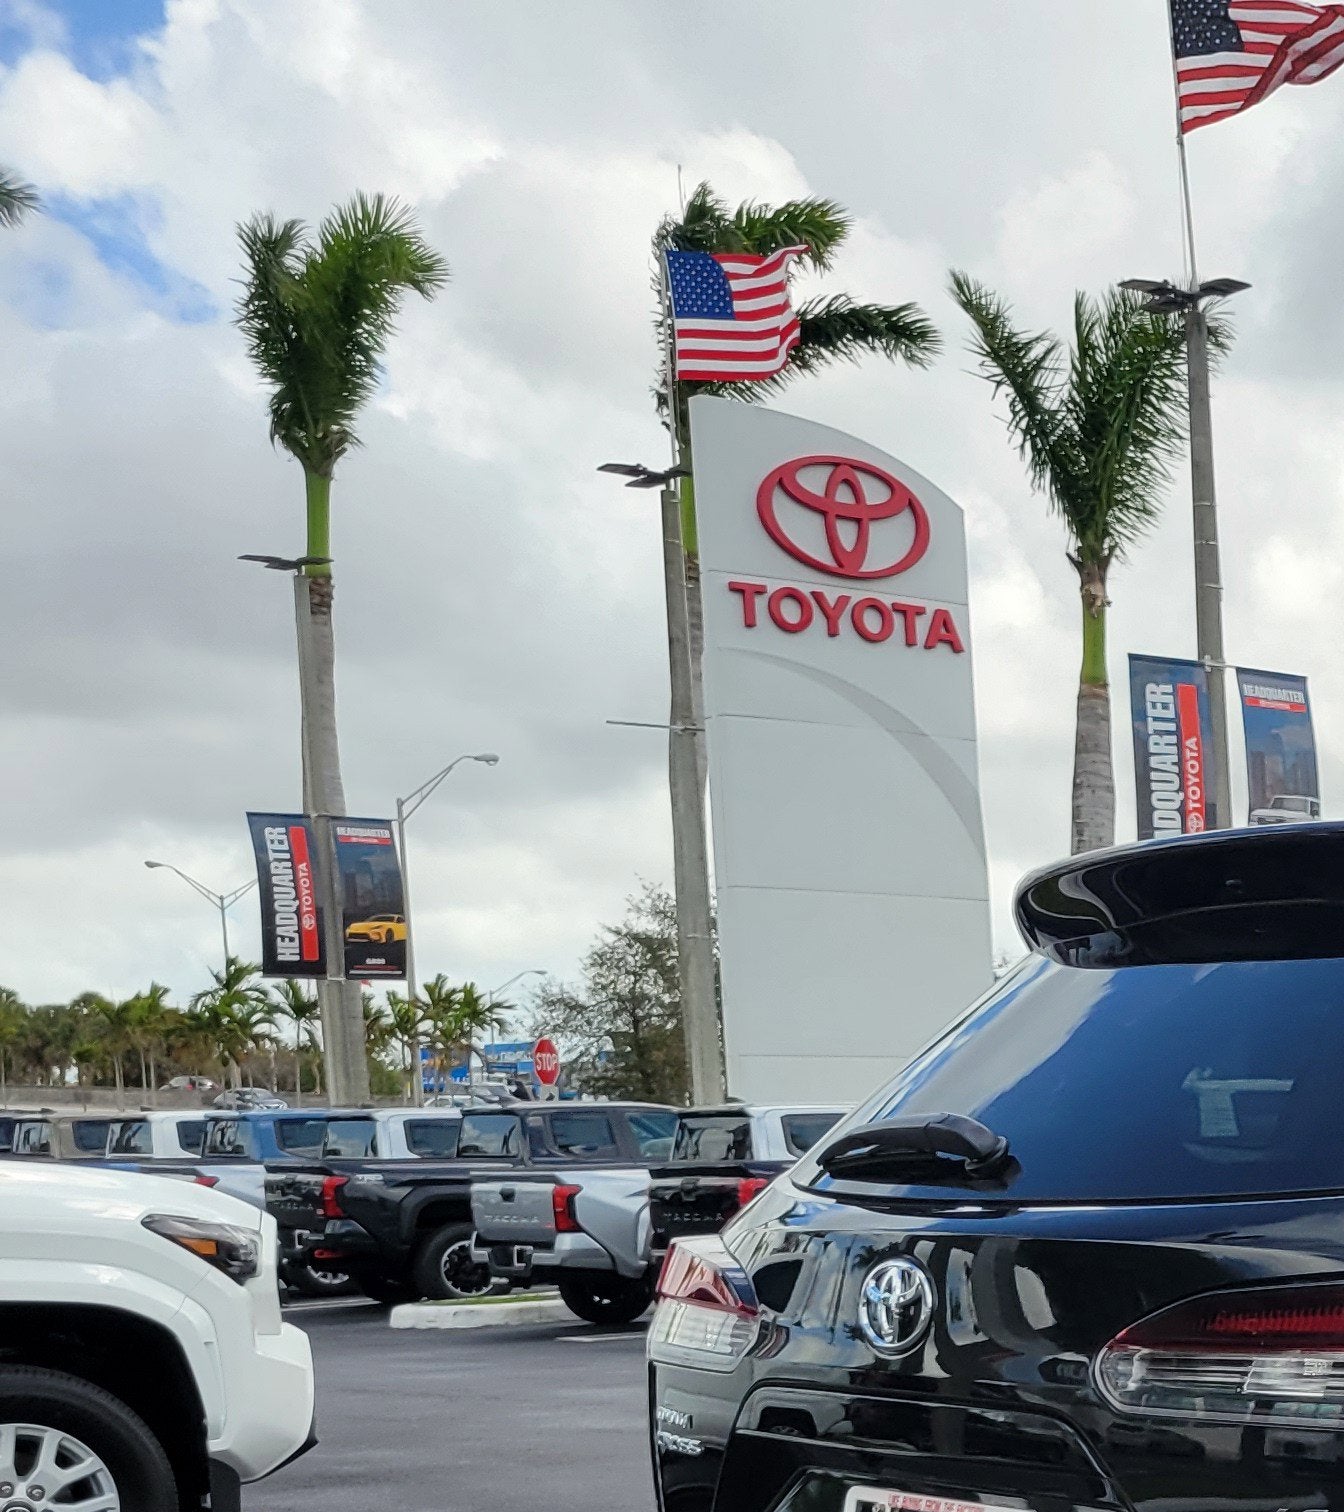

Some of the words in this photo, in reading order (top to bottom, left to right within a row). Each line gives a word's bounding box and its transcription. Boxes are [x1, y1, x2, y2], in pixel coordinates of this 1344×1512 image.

[728, 581, 965, 653] TOYOTA
[1145, 682, 1184, 839] DQUARTER
[1186, 736, 1202, 811] TOYOTA
[264, 826, 300, 962] HEADQUARTER
[297, 862, 313, 912] TOYOTA
[536, 1052, 558, 1071] STOP
